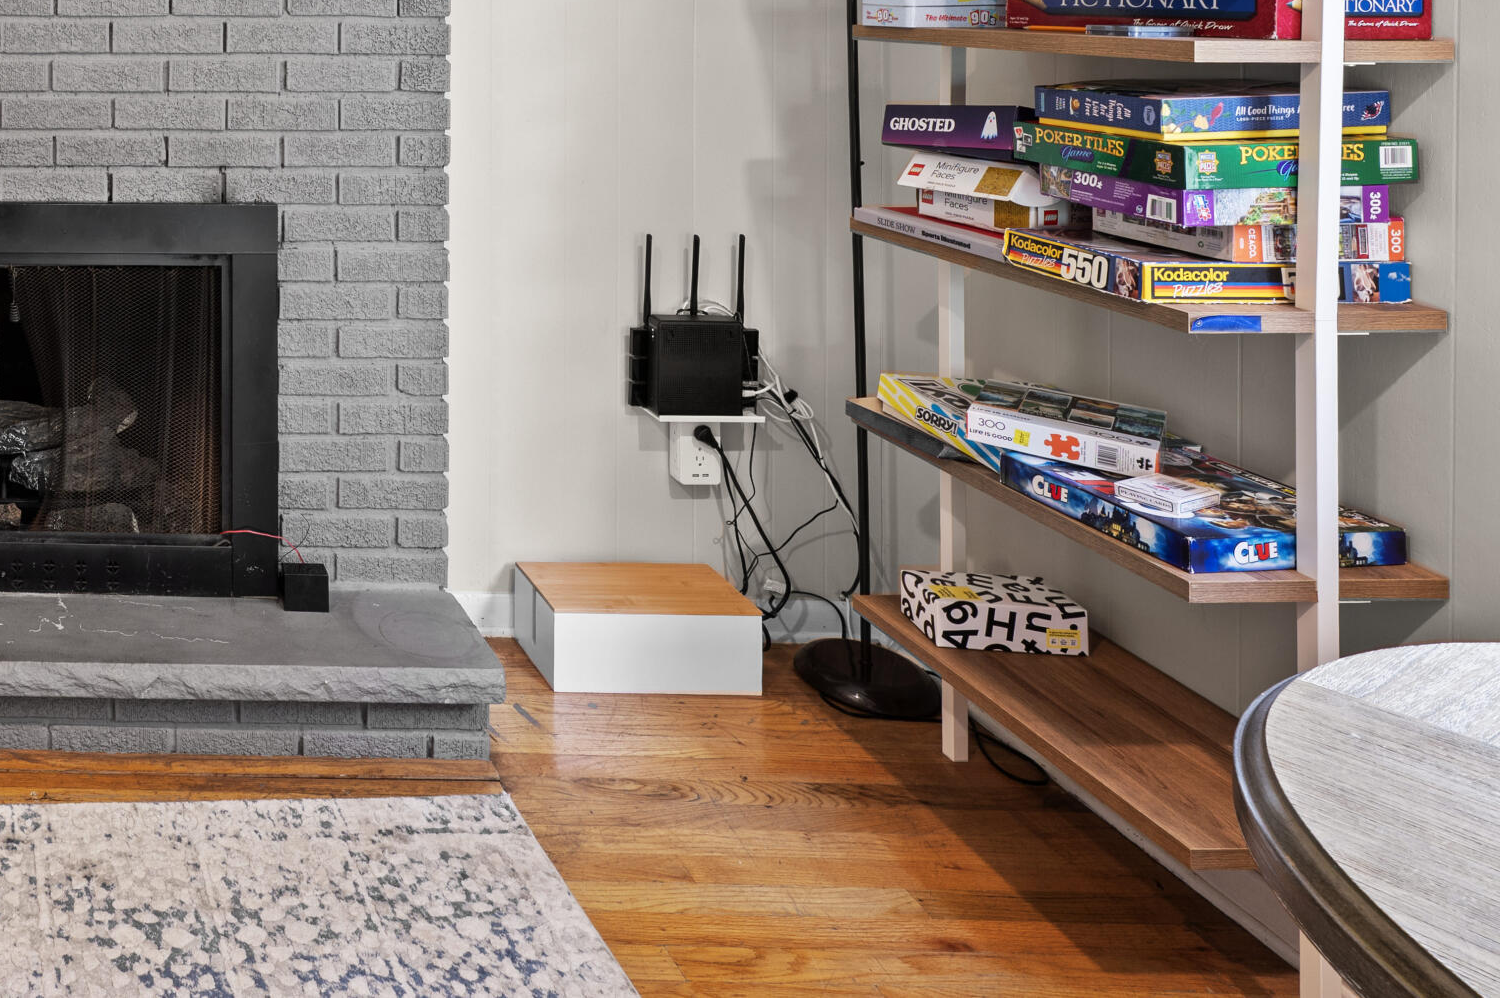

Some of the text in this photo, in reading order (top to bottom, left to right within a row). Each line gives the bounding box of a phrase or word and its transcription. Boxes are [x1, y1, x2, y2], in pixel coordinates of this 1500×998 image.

[938, 14, 968, 22] Ultimate
[1180, 20, 1203, 30] Quick
[1204, 21, 1234, 30] Draw
[1236, 104, 1295, 118] All Good Things
[889, 117, 956, 133] GHOSTED
[1035, 127, 1125, 157] POKER TILES
[1061, 145, 1093, 163] Game
[931, 170, 956, 180] Faces
[935, 162, 980, 175] Minifigure
[1073, 171, 1098, 188] 300
[944, 198, 969, 211] Faces
[1369, 191, 1381, 215] 300
[877, 216, 916, 234] SLIDE SHOW
[921, 230, 971, 250] Sports Illustrated
[1391, 229, 1402, 253] 300
[1010, 234, 1109, 289] Kodacolor 550
[1021, 252, 1056, 268] Puzzles
[1153, 267, 1230, 282] Kodacolor
[1172, 280, 1224, 298] Puzzles
[916, 407, 958, 436] SORRY!
[978, 417, 1006, 431] 300
[991, 433, 1013, 442] GOOD
[1032, 474, 1069, 503] CLUE
[1120, 488, 1148, 502] PLAYING
[1149, 497, 1172, 509] CARDS
[1233, 541, 1278, 565] CLUE
